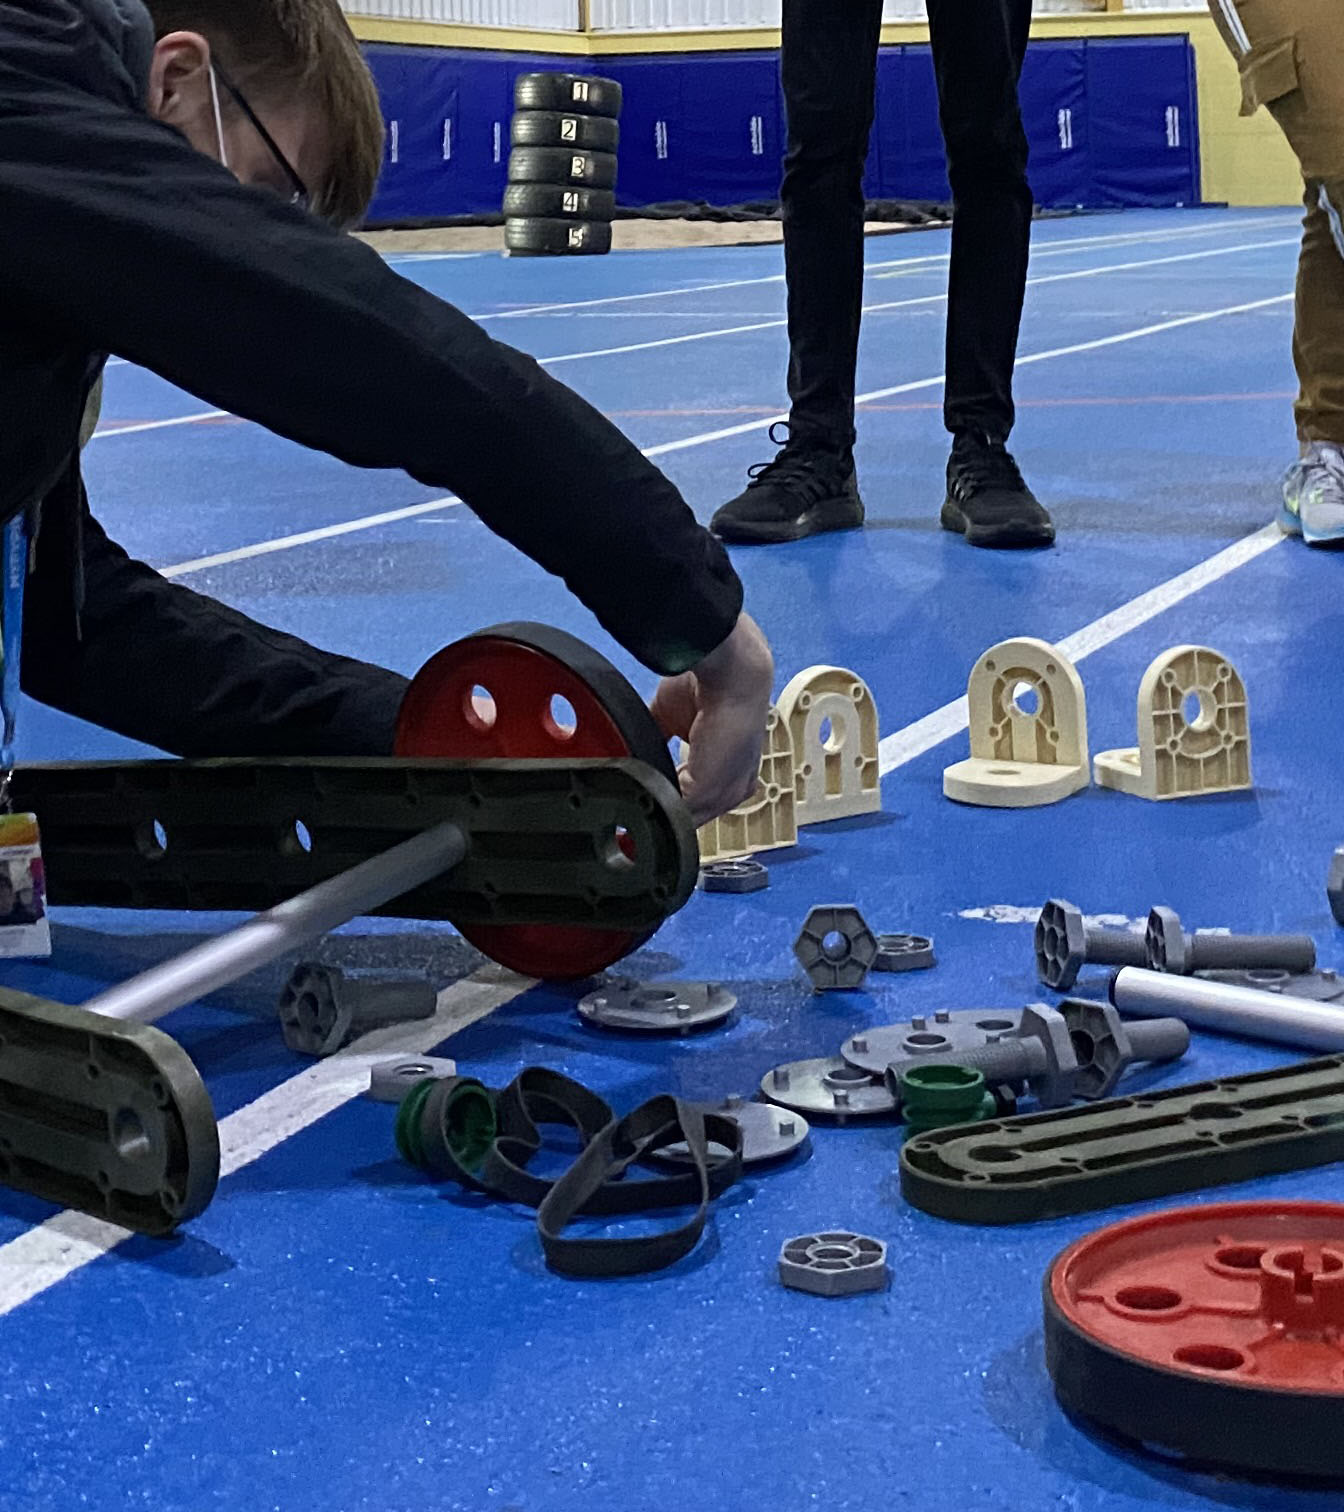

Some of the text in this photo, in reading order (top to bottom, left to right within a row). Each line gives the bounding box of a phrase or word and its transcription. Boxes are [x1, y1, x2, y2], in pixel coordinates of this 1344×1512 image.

[578, 84, 585, 100] 1
[563, 121, 574, 138] 2
[574, 159, 584, 176] 3
[564, 192, 576, 210] 4
[571, 228, 580, 245] 5
